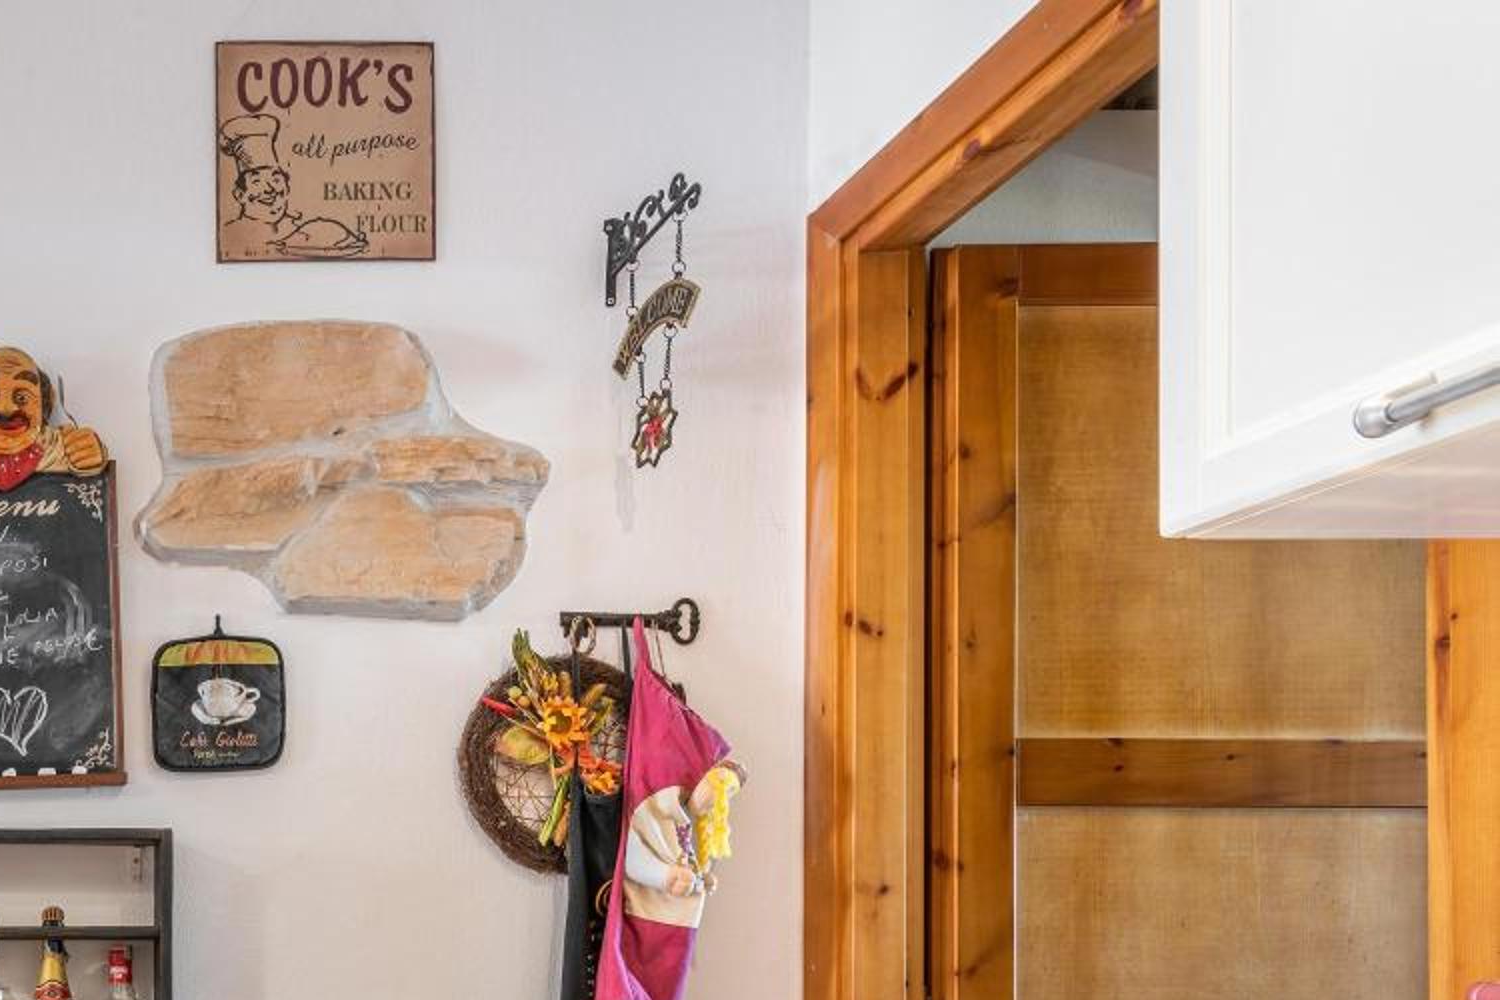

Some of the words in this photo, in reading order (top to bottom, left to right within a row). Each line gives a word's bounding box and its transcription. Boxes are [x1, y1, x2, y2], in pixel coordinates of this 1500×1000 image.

[236, 56, 414, 114] COOK'S
[292, 133, 325, 159] all
[329, 133, 420, 166] purpose
[323, 181, 412, 201] BAKING
[355, 213, 427, 234] FLOUR
